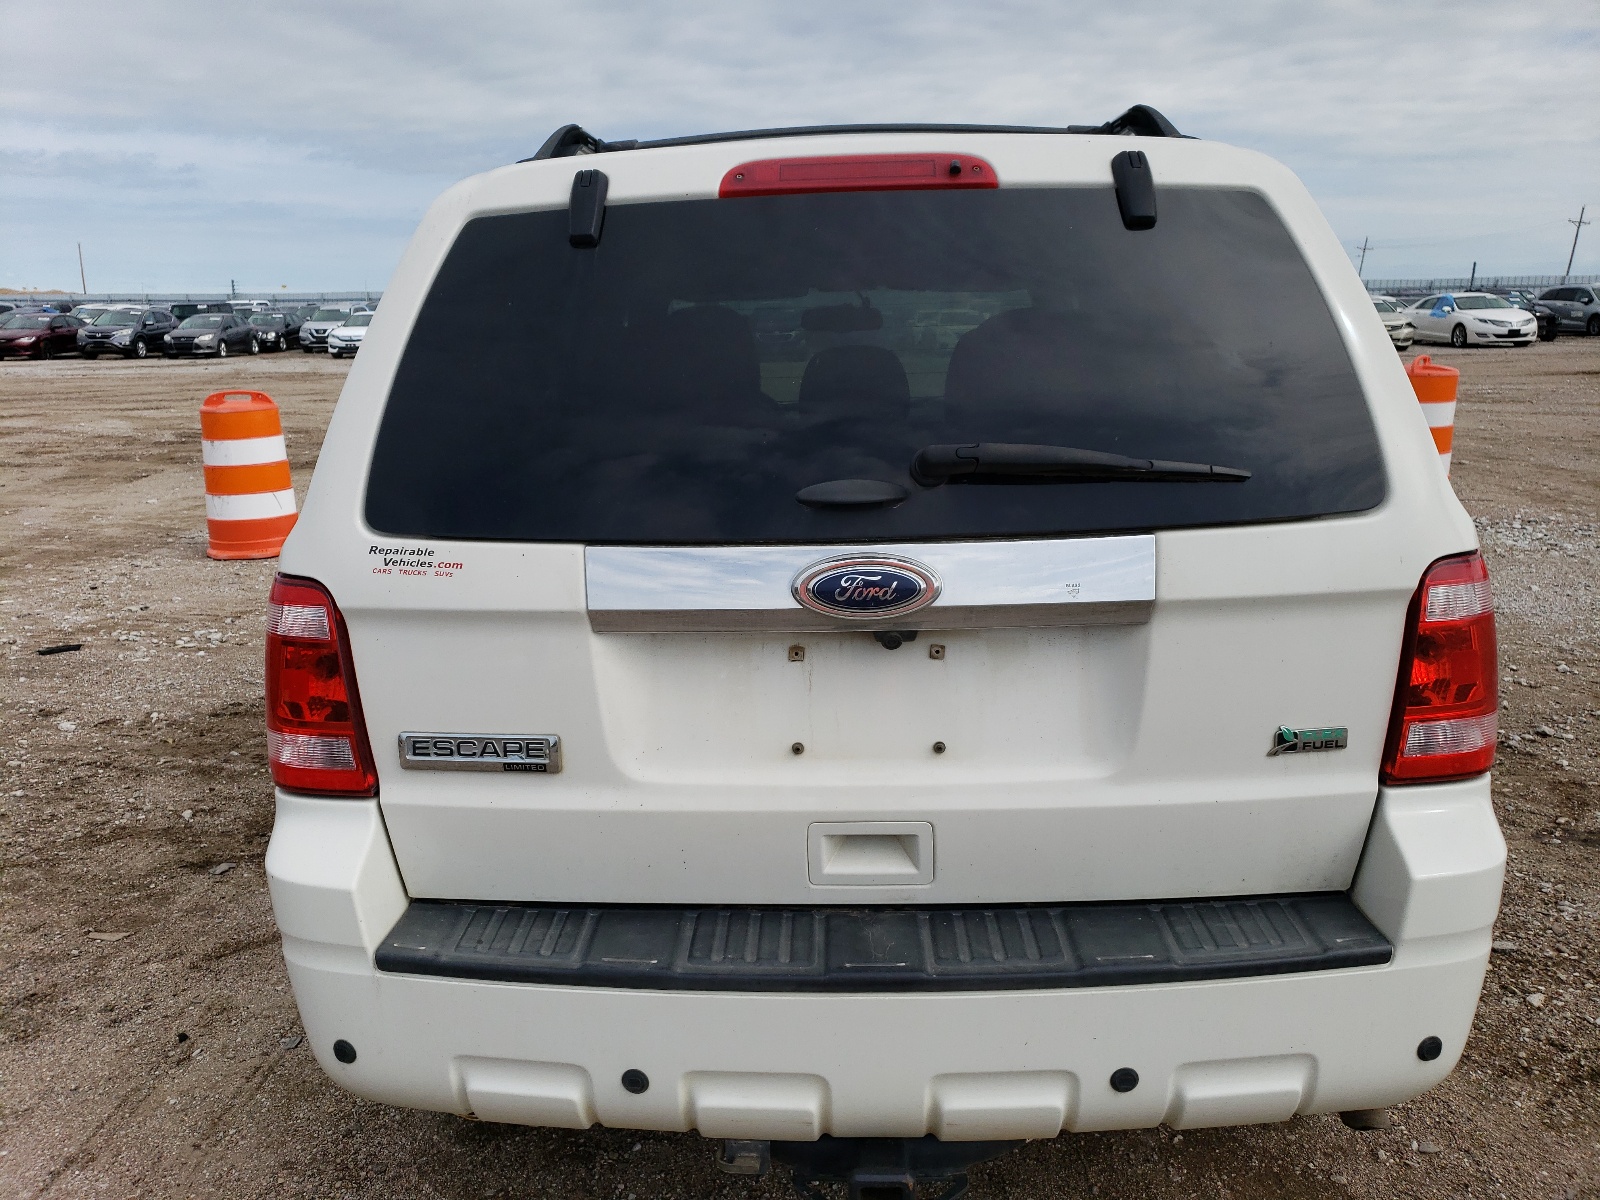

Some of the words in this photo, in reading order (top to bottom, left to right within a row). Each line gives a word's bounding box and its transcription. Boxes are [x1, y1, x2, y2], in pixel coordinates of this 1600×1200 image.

[368, 545, 435, 557] Repairable
[383, 557, 463, 569] Vehicles.com
[834, 574, 898, 601] Ford
[410, 738, 547, 759] ESCAPE
[1302, 739, 1344, 751] FUEL
[504, 763, 546, 772] LIMITED
